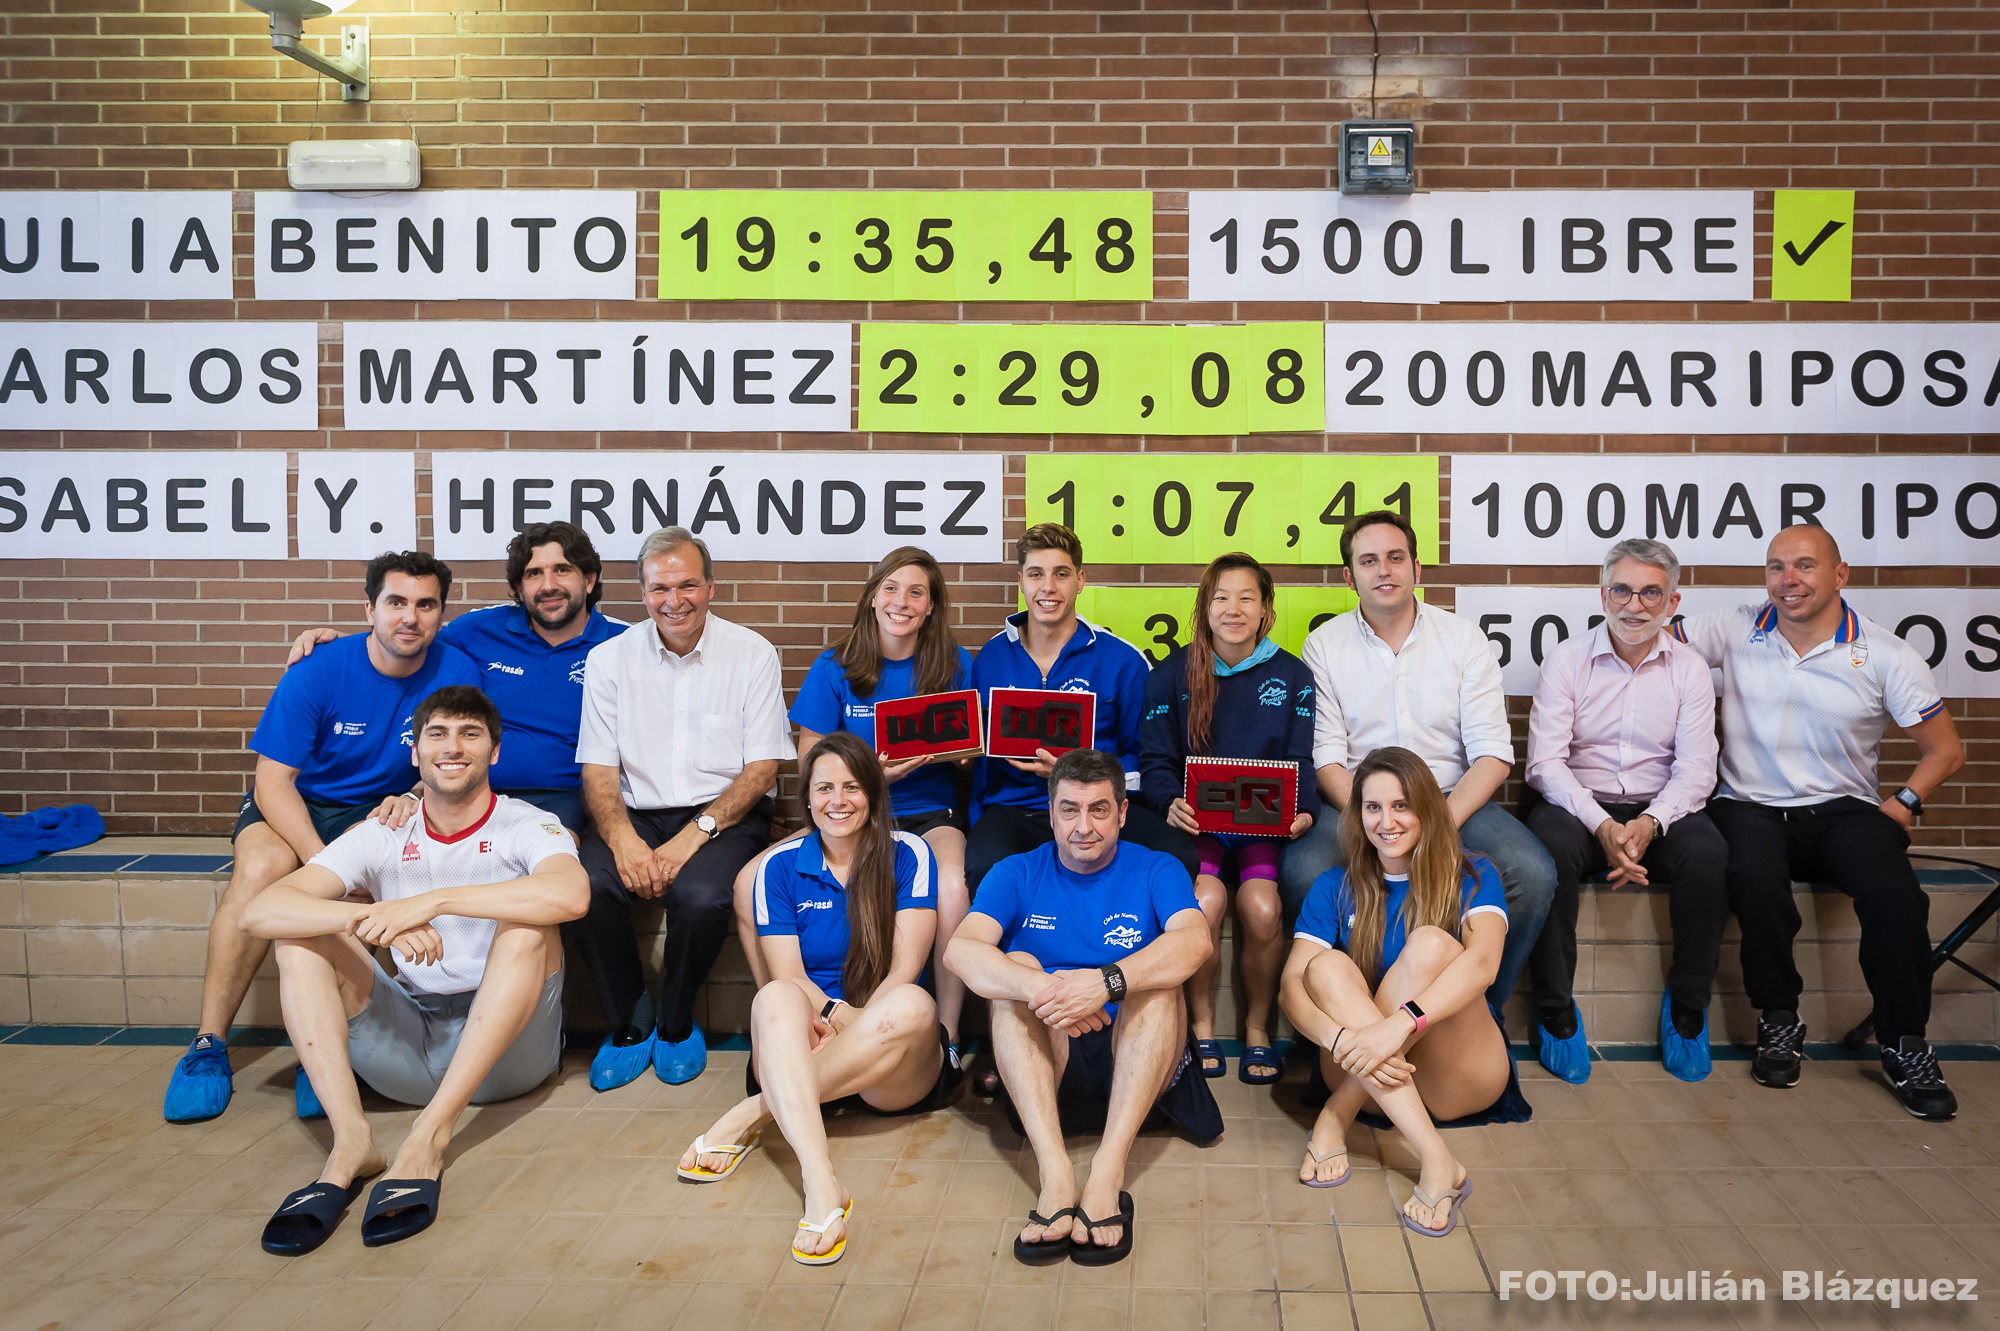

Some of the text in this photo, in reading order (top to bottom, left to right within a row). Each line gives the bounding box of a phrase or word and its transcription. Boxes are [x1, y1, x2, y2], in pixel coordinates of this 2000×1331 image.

[270, 216, 627, 274] BENITO
[680, 216, 1135, 284] 19:35,48
[0, 347, 302, 405] ARLOS
[359, 335, 836, 406] MARTÍNEZ
[879, 348, 1305, 419] 2:29,08
[314, 478, 383, 534] Y.
[449, 465, 988, 535] HERNÁNDEZ
[1046, 480, 1411, 548] 1:07,41
